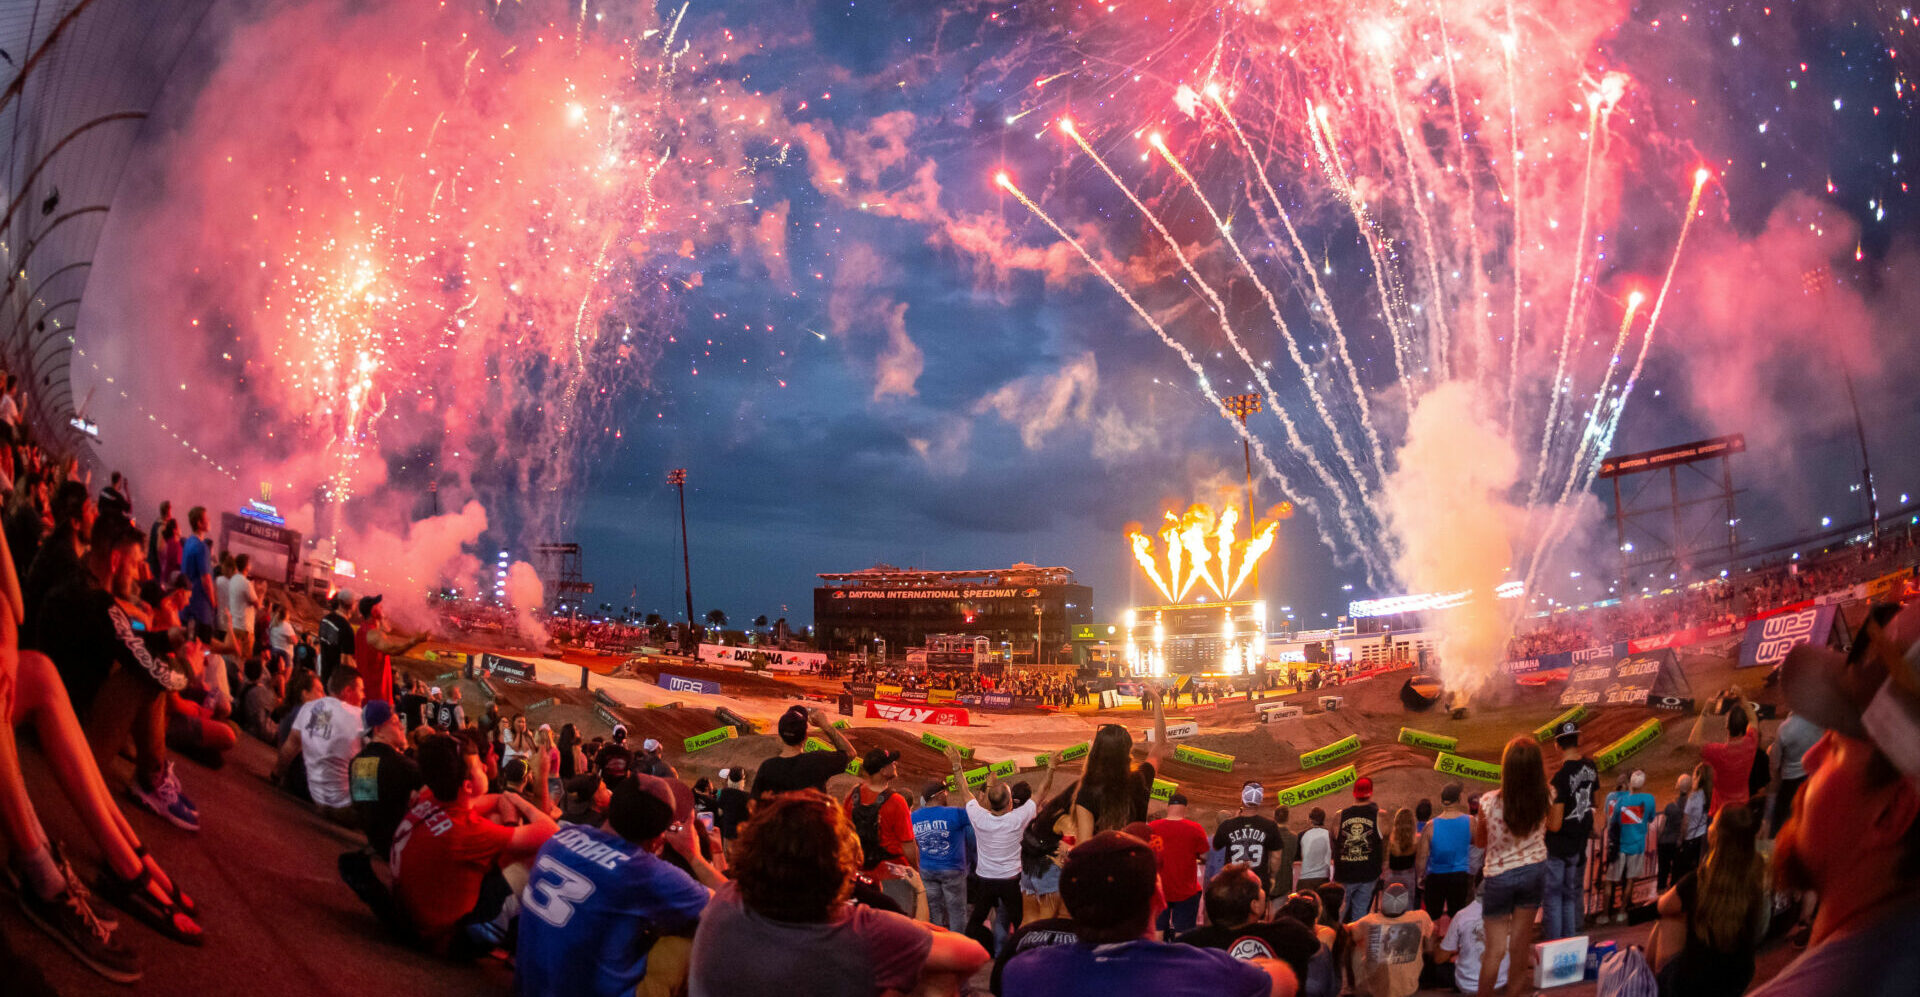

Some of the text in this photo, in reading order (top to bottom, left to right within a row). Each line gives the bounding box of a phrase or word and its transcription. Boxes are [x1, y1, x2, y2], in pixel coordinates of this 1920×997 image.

[244, 522, 280, 538] FINISH
[848, 589, 1018, 599] DAYTONA INTERNATIONAL SPEEDWAY
[1762, 609, 1817, 640] WPS
[1509, 659, 1540, 669] YAMAHA
[670, 677, 703, 694] WPS
[695, 731, 729, 748] Kawasaki
[1167, 727, 1191, 737] METIC
[931, 738, 969, 758] Kawki
[1315, 741, 1359, 762] Kawasaki
[1455, 763, 1499, 780] Kawasa
[1297, 772, 1355, 801] Kawasaki
[1229, 828, 1267, 843] SEXTON
[1230, 844, 1264, 868] 23
[522, 853, 597, 928] 3
[1233, 941, 1265, 957] ACM
